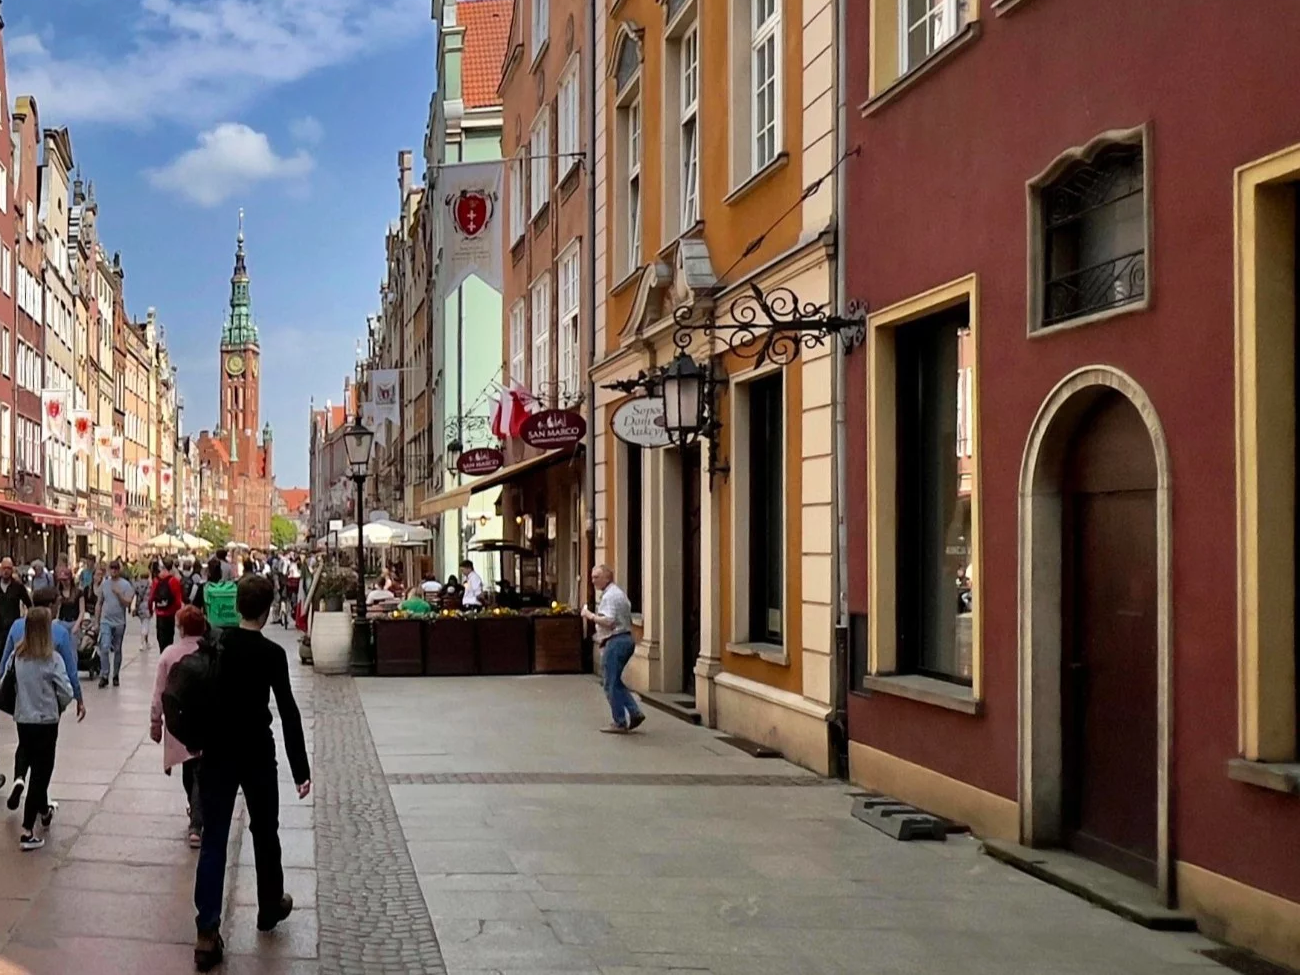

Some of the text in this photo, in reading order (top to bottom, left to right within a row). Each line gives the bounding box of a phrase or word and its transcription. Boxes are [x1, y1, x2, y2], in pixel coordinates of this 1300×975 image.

[624, 415, 651, 427] Dom
[528, 428, 546, 440] SAN
[547, 426, 580, 437] MARCO
